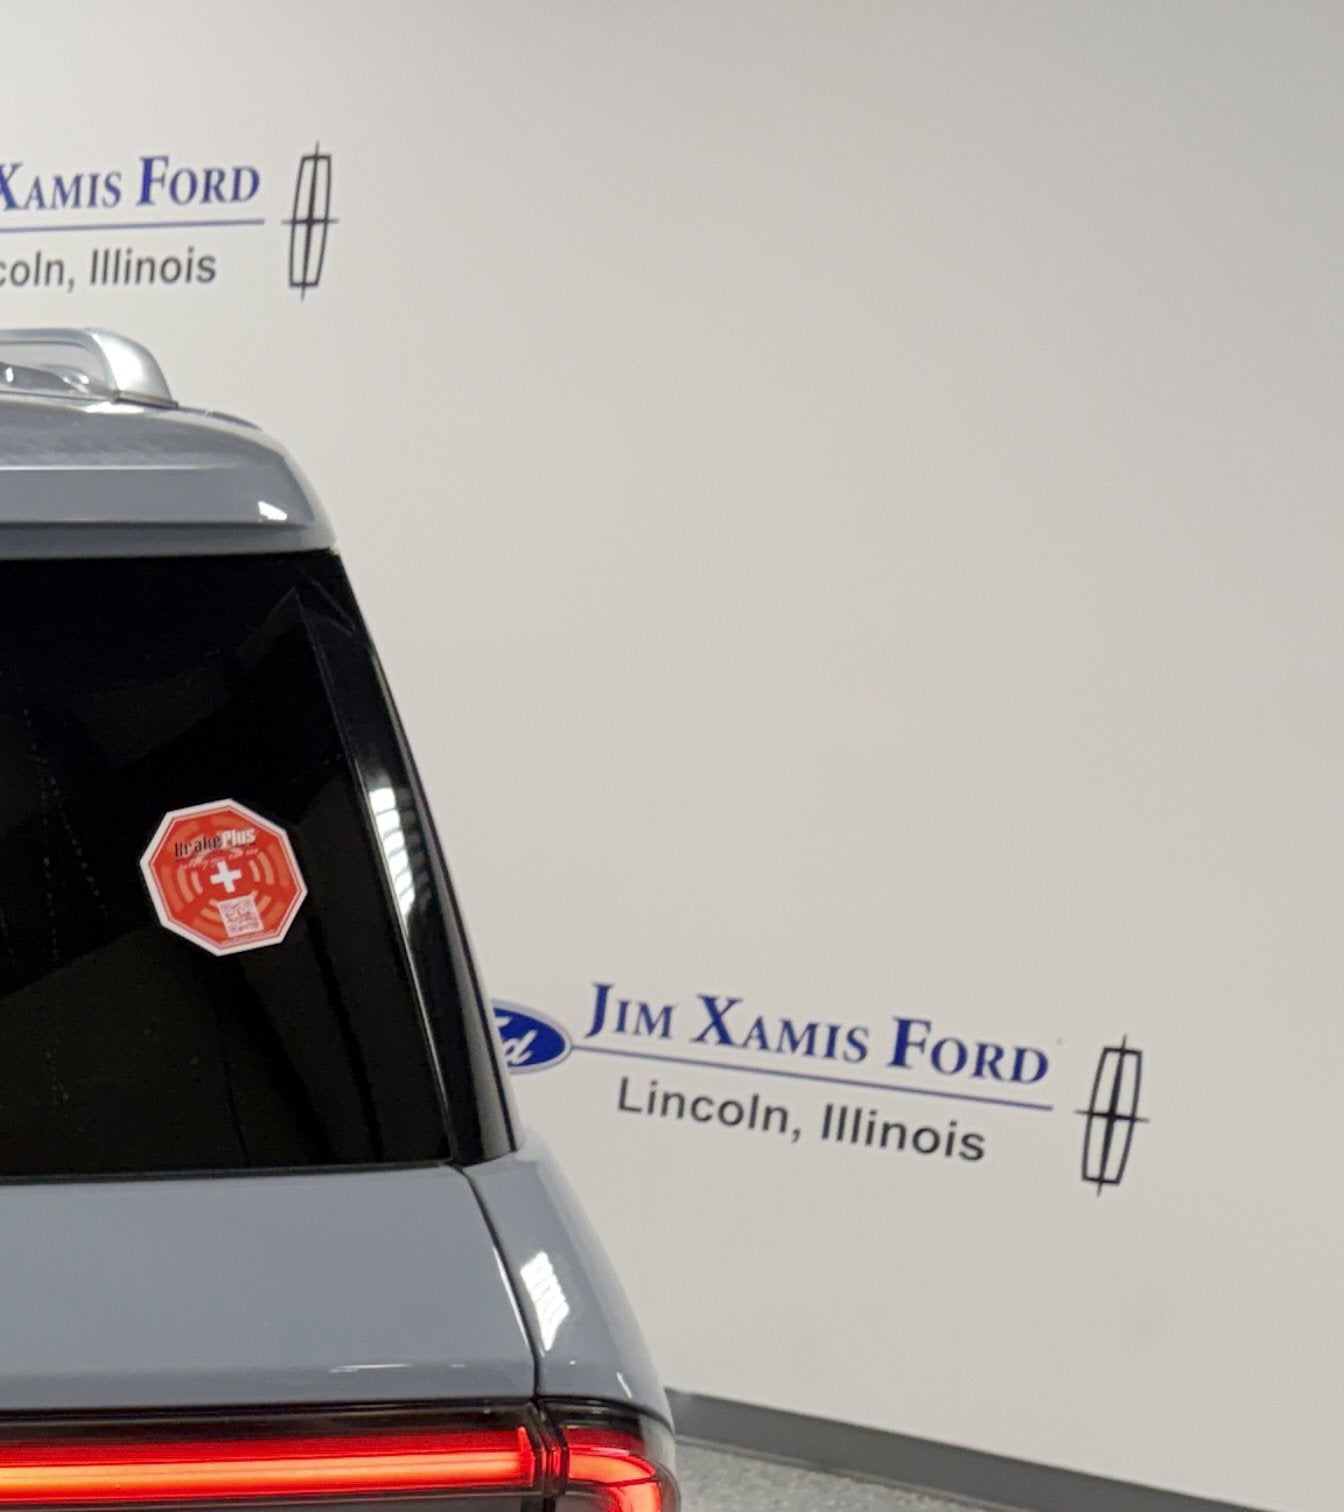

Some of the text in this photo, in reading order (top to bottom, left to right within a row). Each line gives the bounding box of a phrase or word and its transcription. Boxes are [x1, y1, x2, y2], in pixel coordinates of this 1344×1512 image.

[136, 154, 261, 207] FORD
[89, 246, 217, 287] Illinois
[584, 981, 677, 1040] JIM
[691, 993, 872, 1064] XAMIS
[888, 1015, 1051, 1087] FORD
[616, 1075, 987, 1163] Lincoln, Illinois
